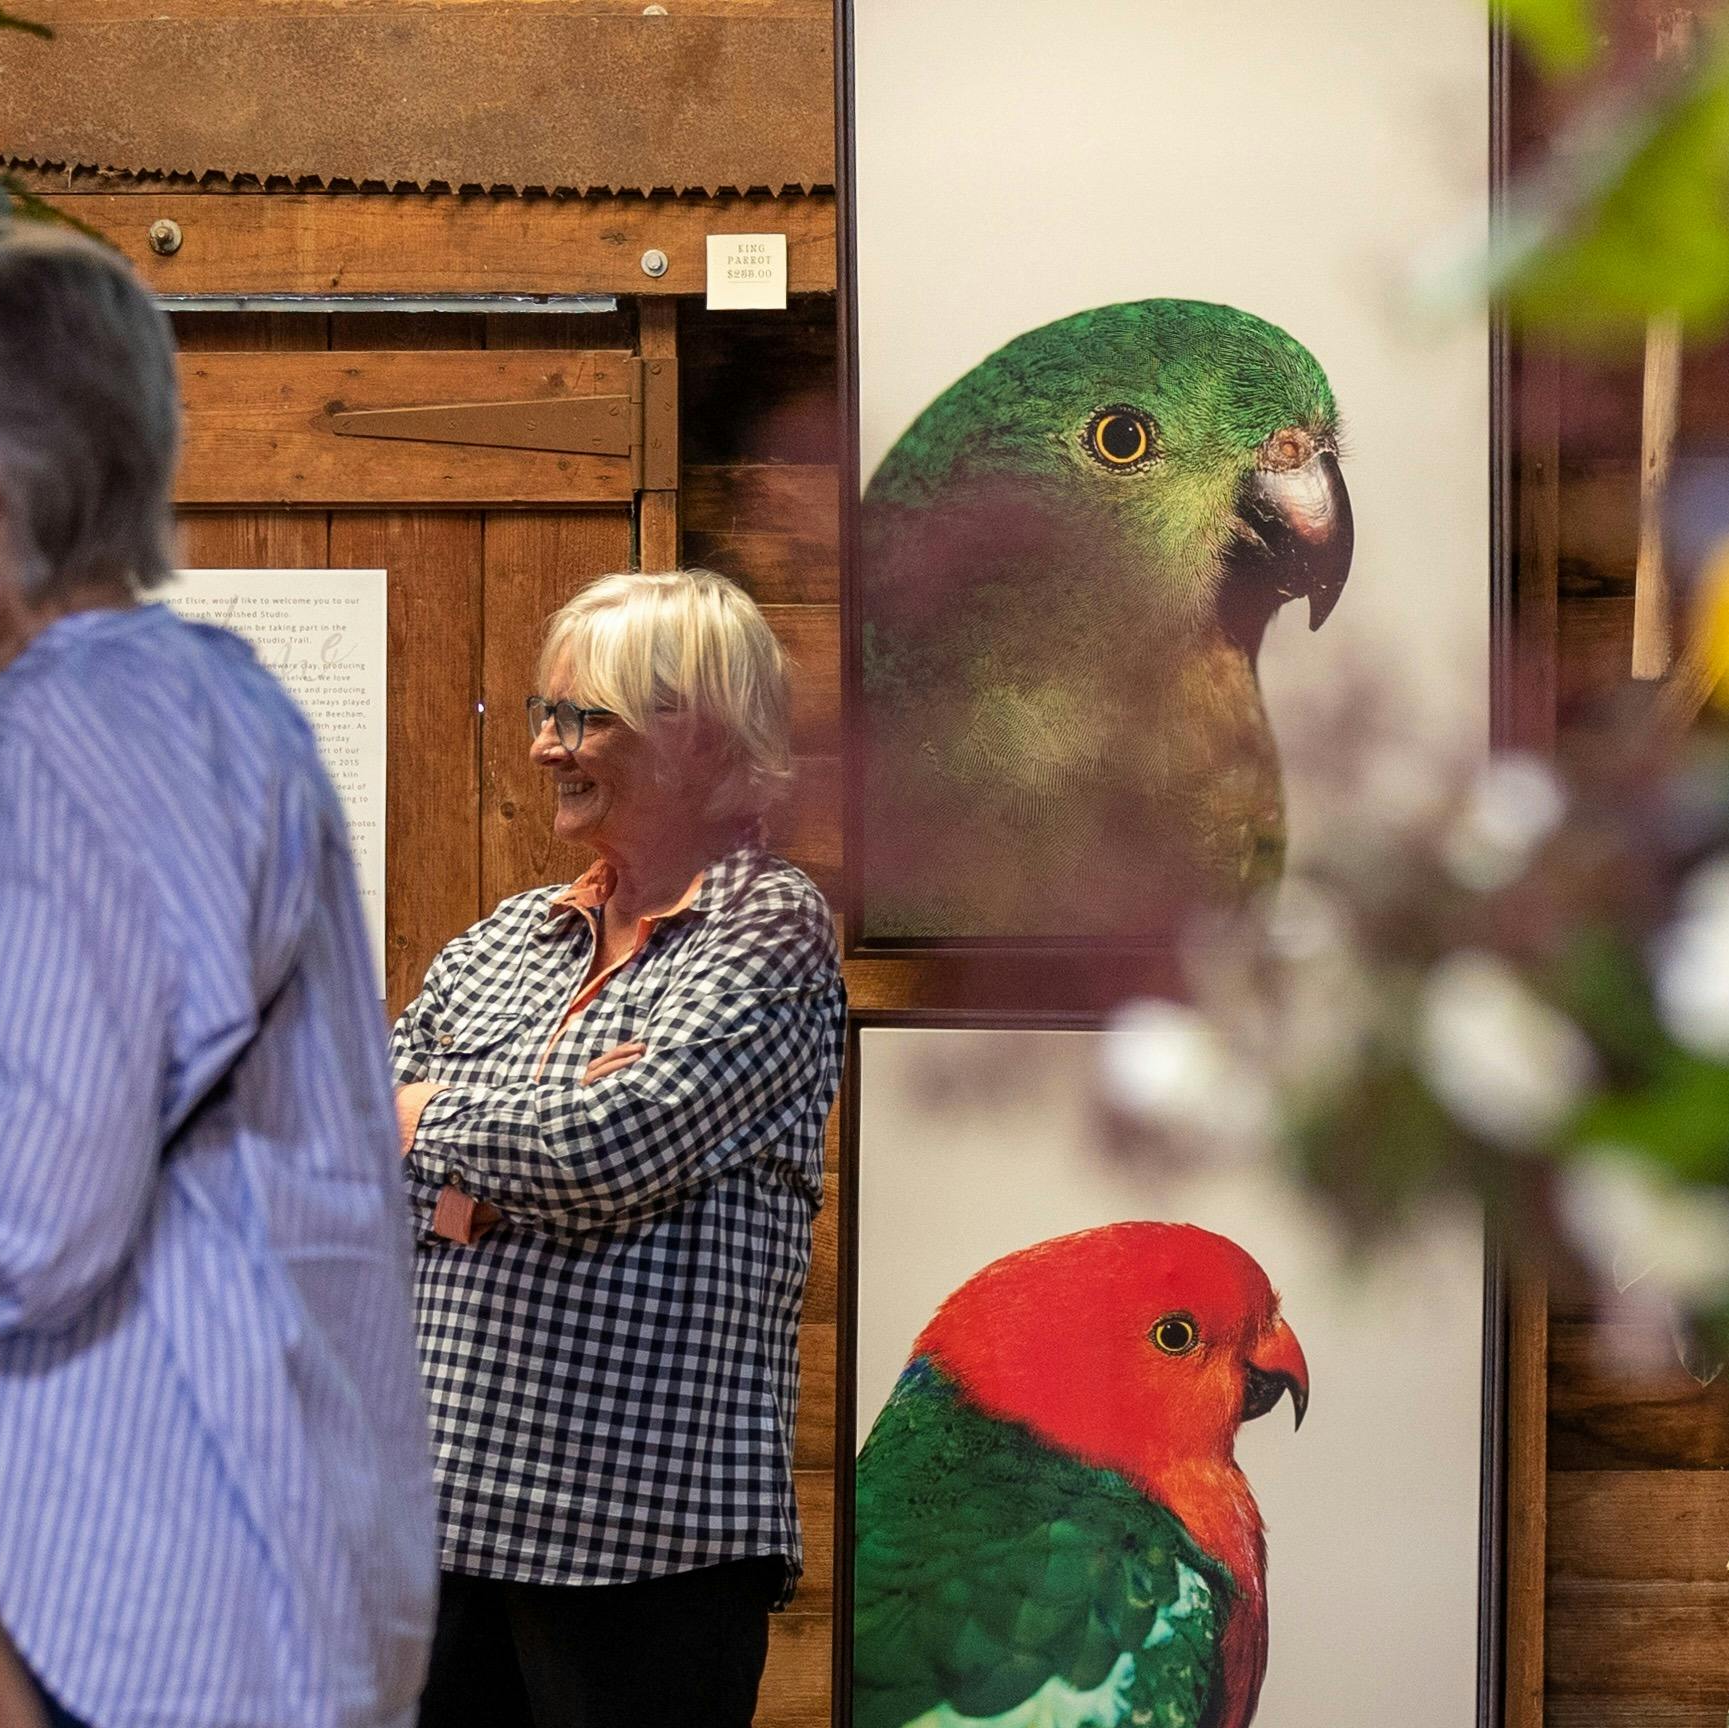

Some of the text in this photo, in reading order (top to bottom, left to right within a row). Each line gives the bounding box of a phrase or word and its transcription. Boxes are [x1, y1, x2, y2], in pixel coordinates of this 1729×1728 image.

[738, 244, 765, 253] KING
[727, 256, 772, 265] PARROT
[167, 597, 182, 605] and
[212, 597, 238, 605] would
[242, 597, 257, 605] like
[260, 597, 269, 605] to
[272, 597, 311, 605] welcome
[314, 598, 329, 606] you
[269, 624, 296, 632] taking
[299, 624, 318, 632] part
[323, 662, 365, 670] producing
[305, 686, 320, 694] and
[323, 687, 366, 695] producing
[311, 699, 339, 707] always
[342, 699, 370, 707] played
[314, 735, 350, 743] aturday
[339, 759, 360, 767] 2015
[359, 795, 368, 803] to
